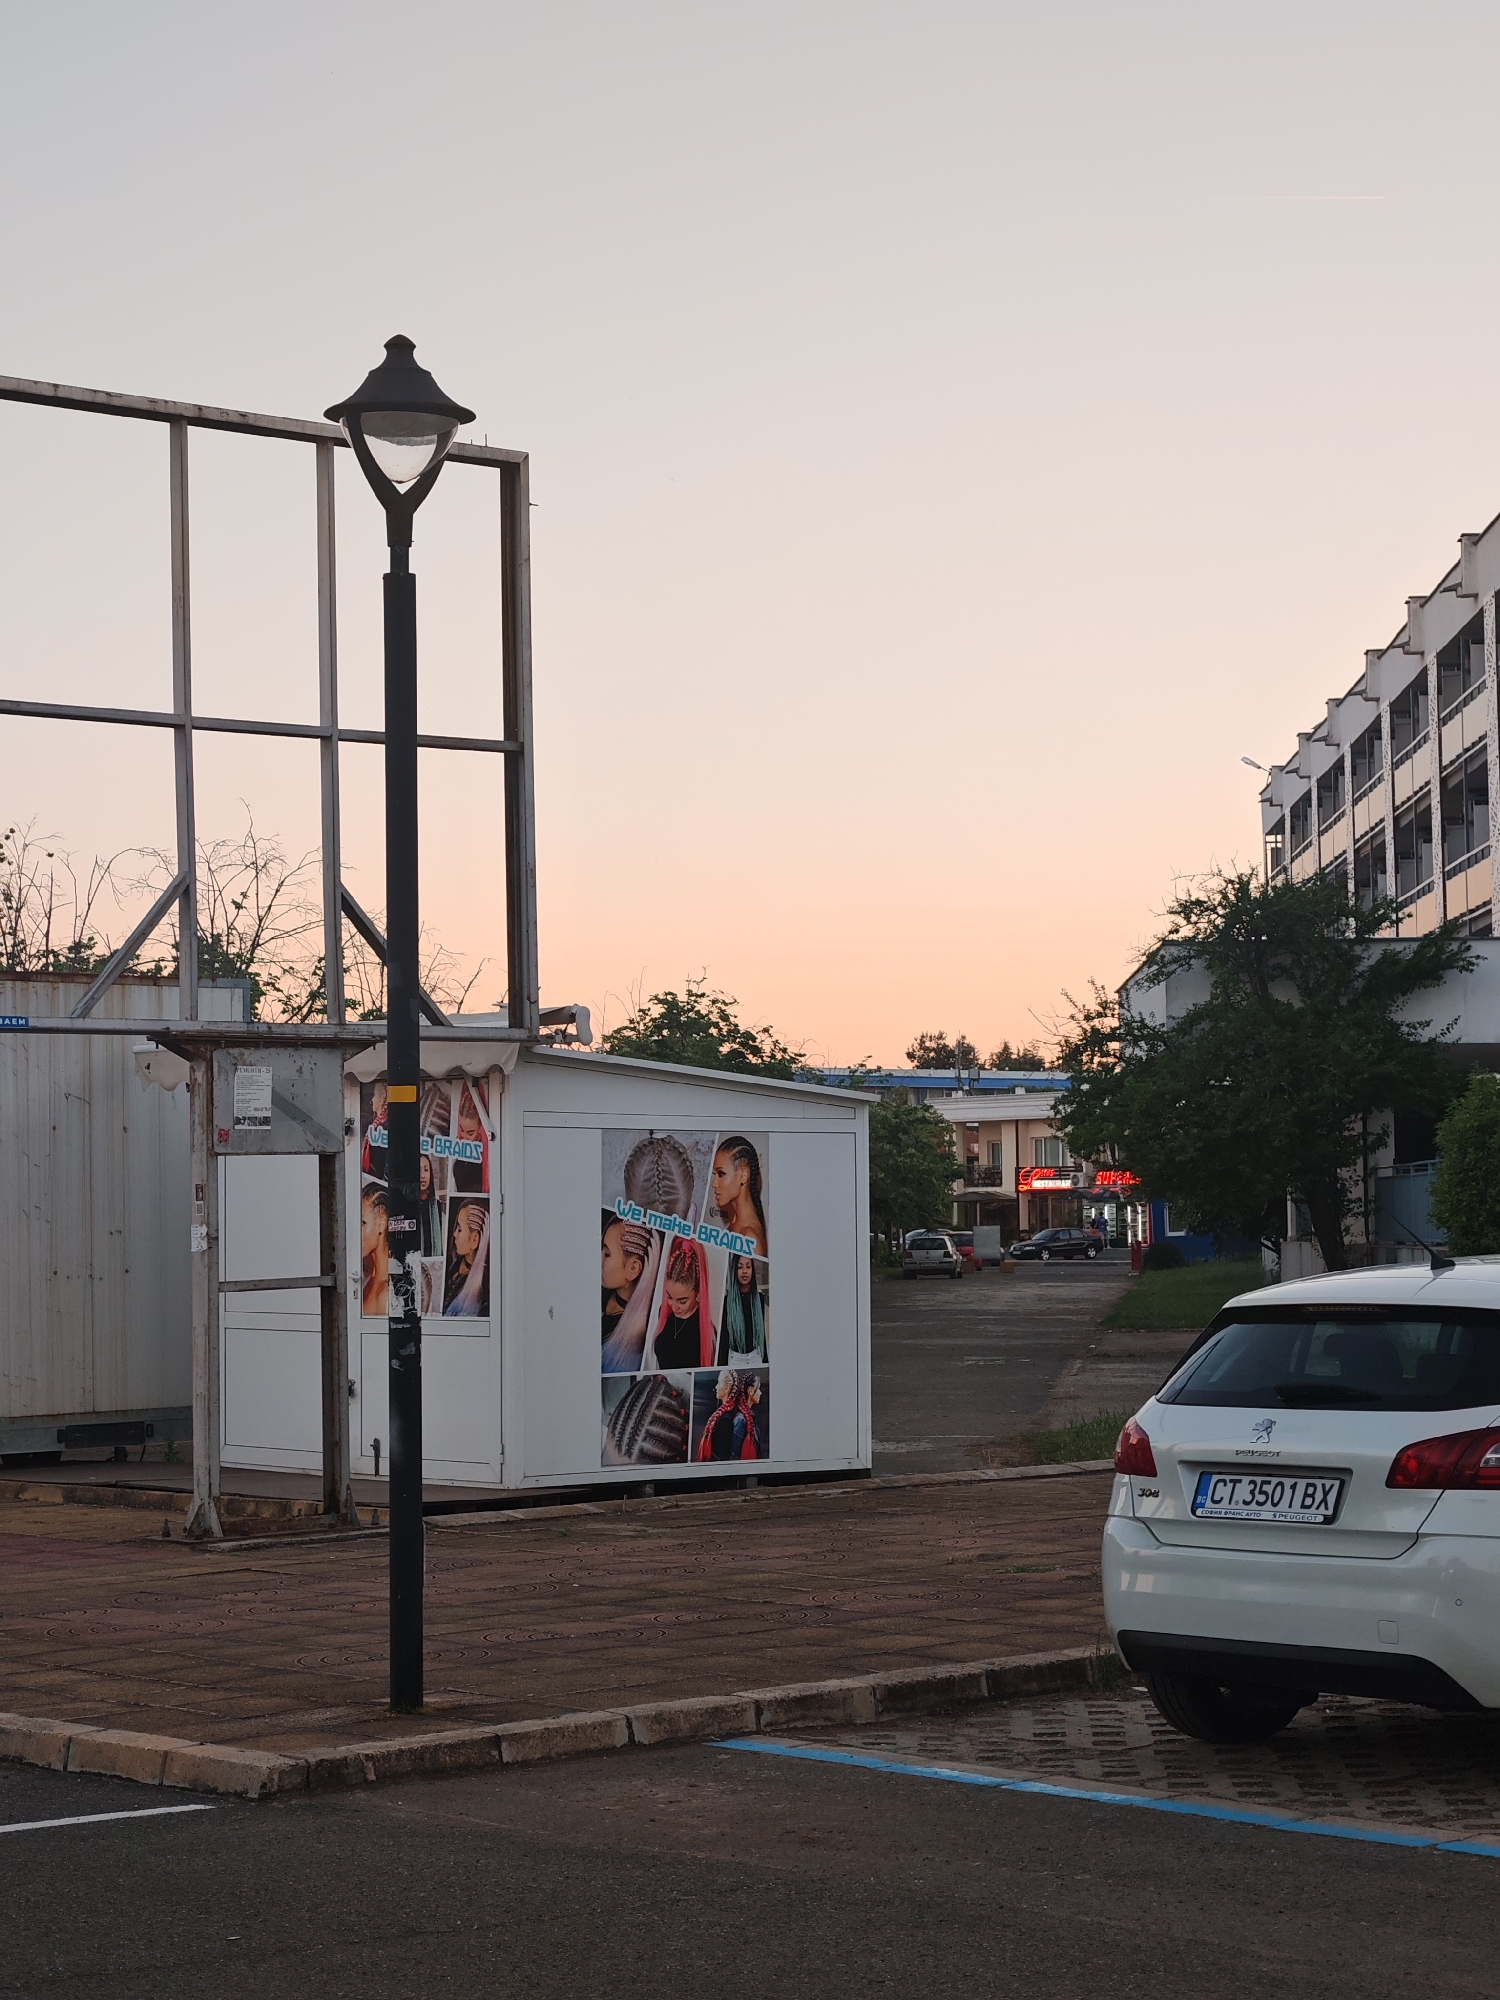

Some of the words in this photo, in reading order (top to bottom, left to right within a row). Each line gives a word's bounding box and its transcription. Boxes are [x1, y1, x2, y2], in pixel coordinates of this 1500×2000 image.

[435, 1137, 481, 1161] BRAIDS
[617, 1199, 642, 1222] We
[698, 1224, 755, 1256] BRAIDS
[1235, 1449, 1281, 1457] PEUGEOT
[1137, 1487, 1160, 1498] 308
[1278, 1513, 1318, 1522] PEUGEOT
